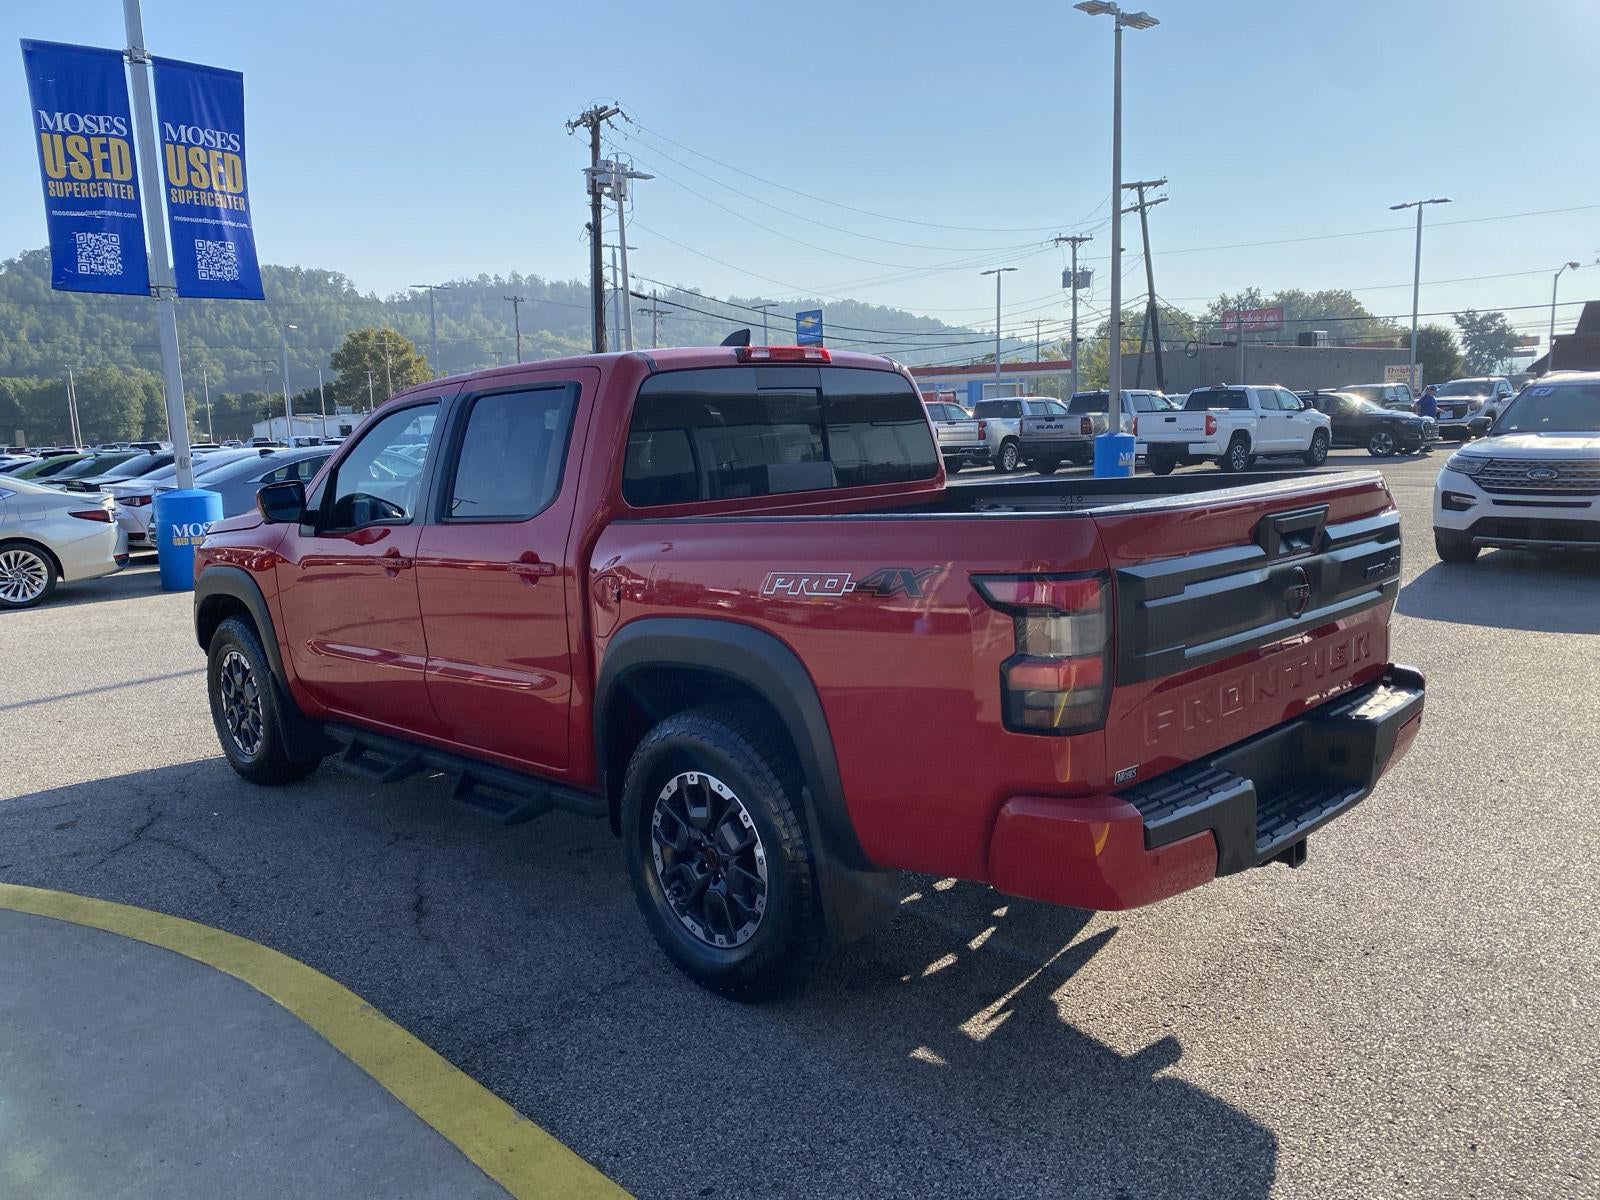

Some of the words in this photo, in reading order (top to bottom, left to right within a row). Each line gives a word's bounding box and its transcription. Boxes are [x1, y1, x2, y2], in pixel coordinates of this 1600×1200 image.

[37, 109, 128, 137] MOSES
[164, 122, 241, 152] MOSES
[40, 132, 133, 181] USED
[165, 143, 244, 194] USED
[48, 180, 135, 200] SUPERCENTER
[170, 188, 246, 212] SUPERCENTER
[51, 209, 137, 219] mosesusedsupercenter.com
[173, 215, 249, 229] mosesusedsupercenter.com
[1144, 631, 1371, 746] FRONTIER
